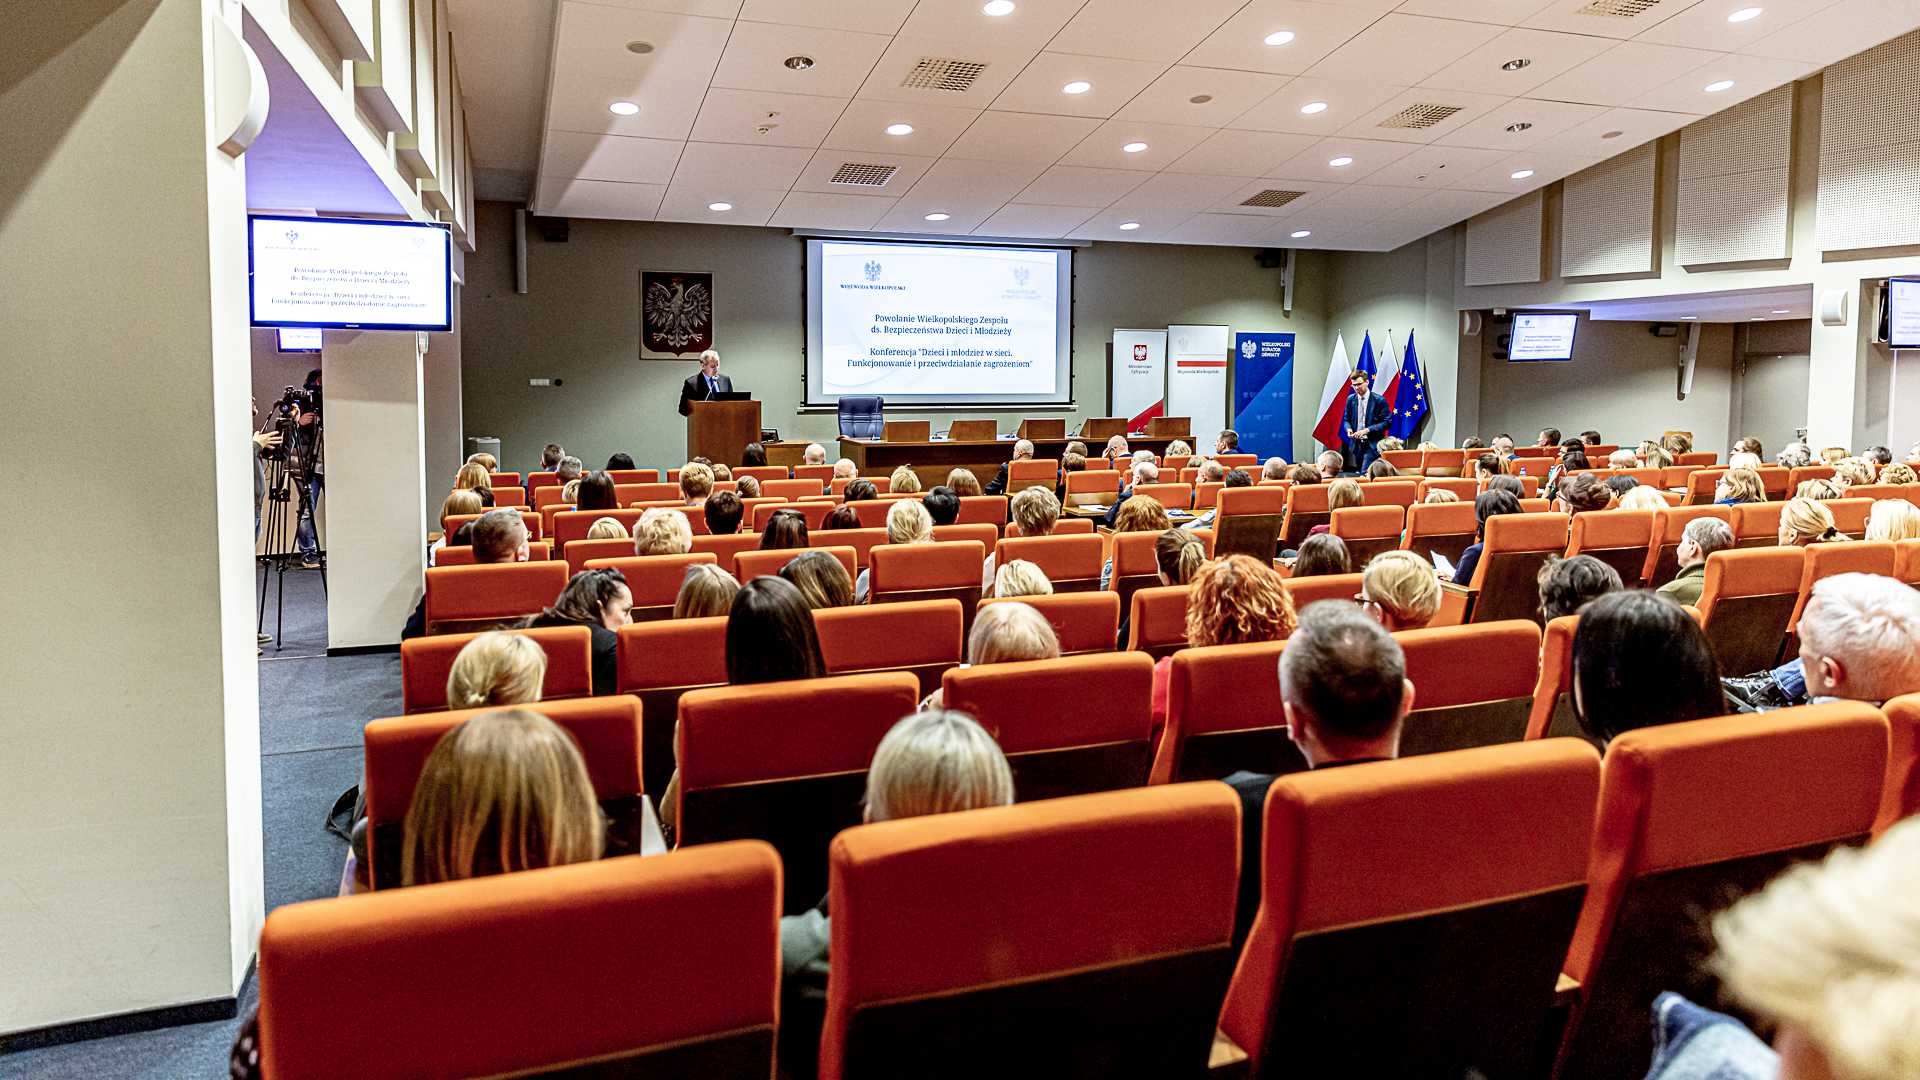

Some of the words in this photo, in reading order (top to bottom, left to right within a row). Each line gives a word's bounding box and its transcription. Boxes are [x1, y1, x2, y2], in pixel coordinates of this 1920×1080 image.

[917, 314, 979, 326] Wielkopolskiego
[979, 316, 1009, 326] Zespołu
[870, 325, 882, 333] ds.
[883, 325, 944, 335] Bezpieczeństwa
[946, 326, 969, 335] Dzieci
[974, 327, 1012, 337] Młodzieży
[870, 347, 917, 357] Konferencja
[994, 348, 1013, 357] sieci.
[847, 358, 912, 369] Funkcjonowanie
